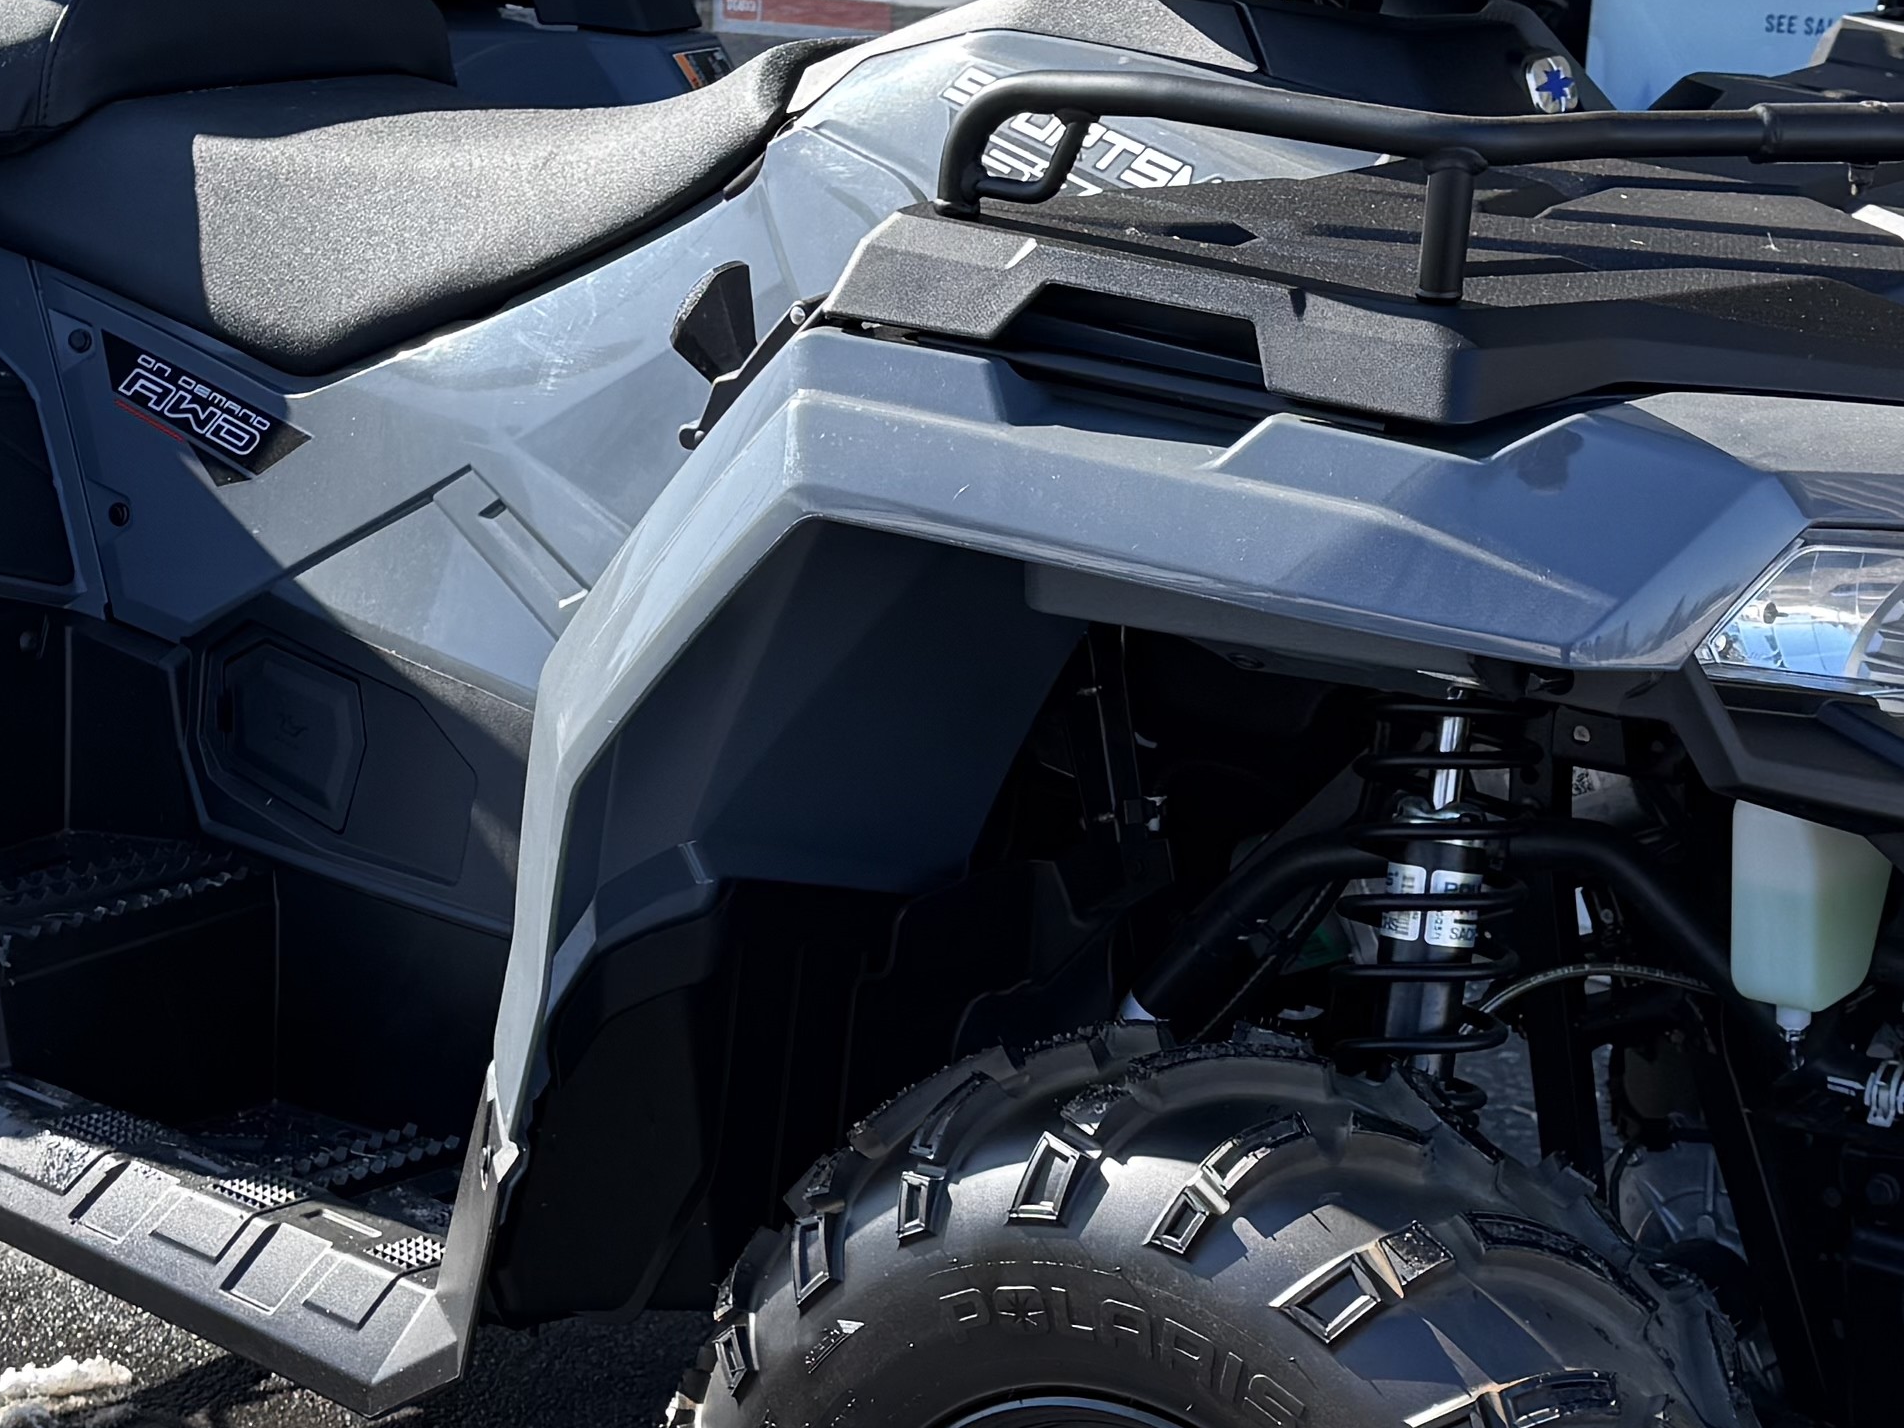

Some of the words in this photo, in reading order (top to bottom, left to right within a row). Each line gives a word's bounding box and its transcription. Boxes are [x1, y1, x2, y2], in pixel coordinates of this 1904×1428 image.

[1765, 14, 1797, 35] SEE
[118, 367, 261, 456] AWD
[137, 354, 172, 377] ON
[177, 375, 271, 432] DEMAND
